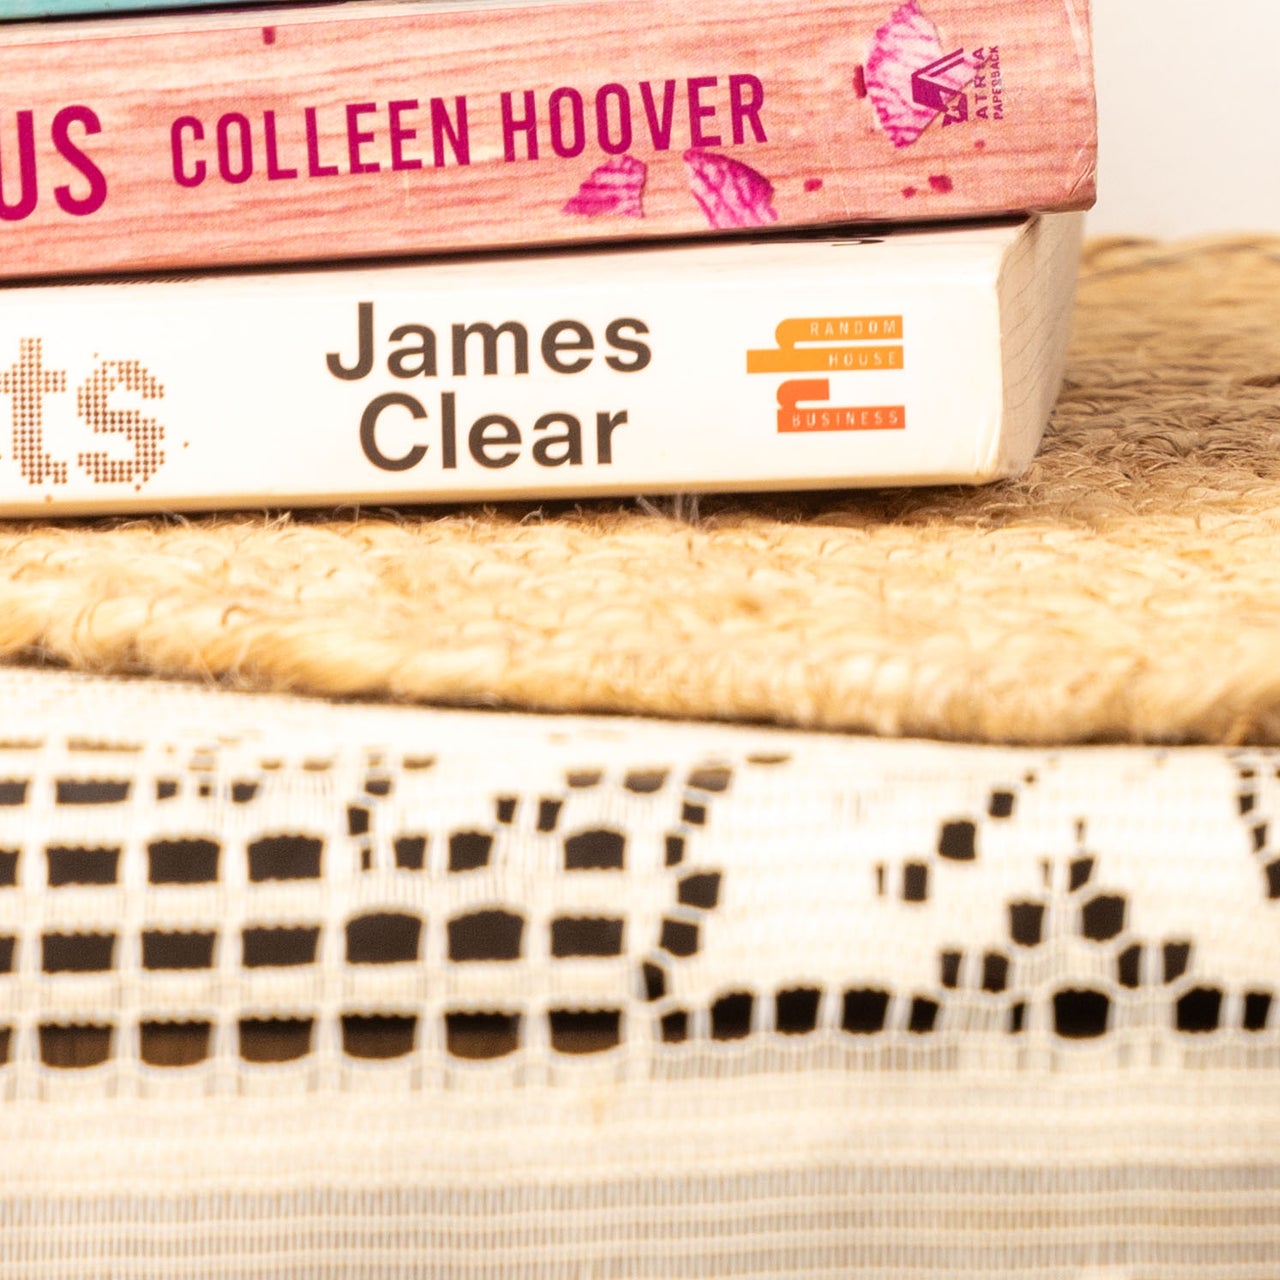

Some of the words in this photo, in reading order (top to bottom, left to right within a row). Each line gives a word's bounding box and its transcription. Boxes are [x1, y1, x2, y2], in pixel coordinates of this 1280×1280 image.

[972, 47, 988, 119] ATRIA
[989, 45, 1003, 120] PAPERBACK
[171, 94, 470, 188] COLLEEN
[502, 73, 769, 163] HOOVER
[325, 302, 652, 381] James
[809, 319, 897, 336] RANDOM
[828, 351, 896, 367] HOUSE
[359, 389, 628, 471] Clear
[791, 410, 898, 427] BUSINESS
